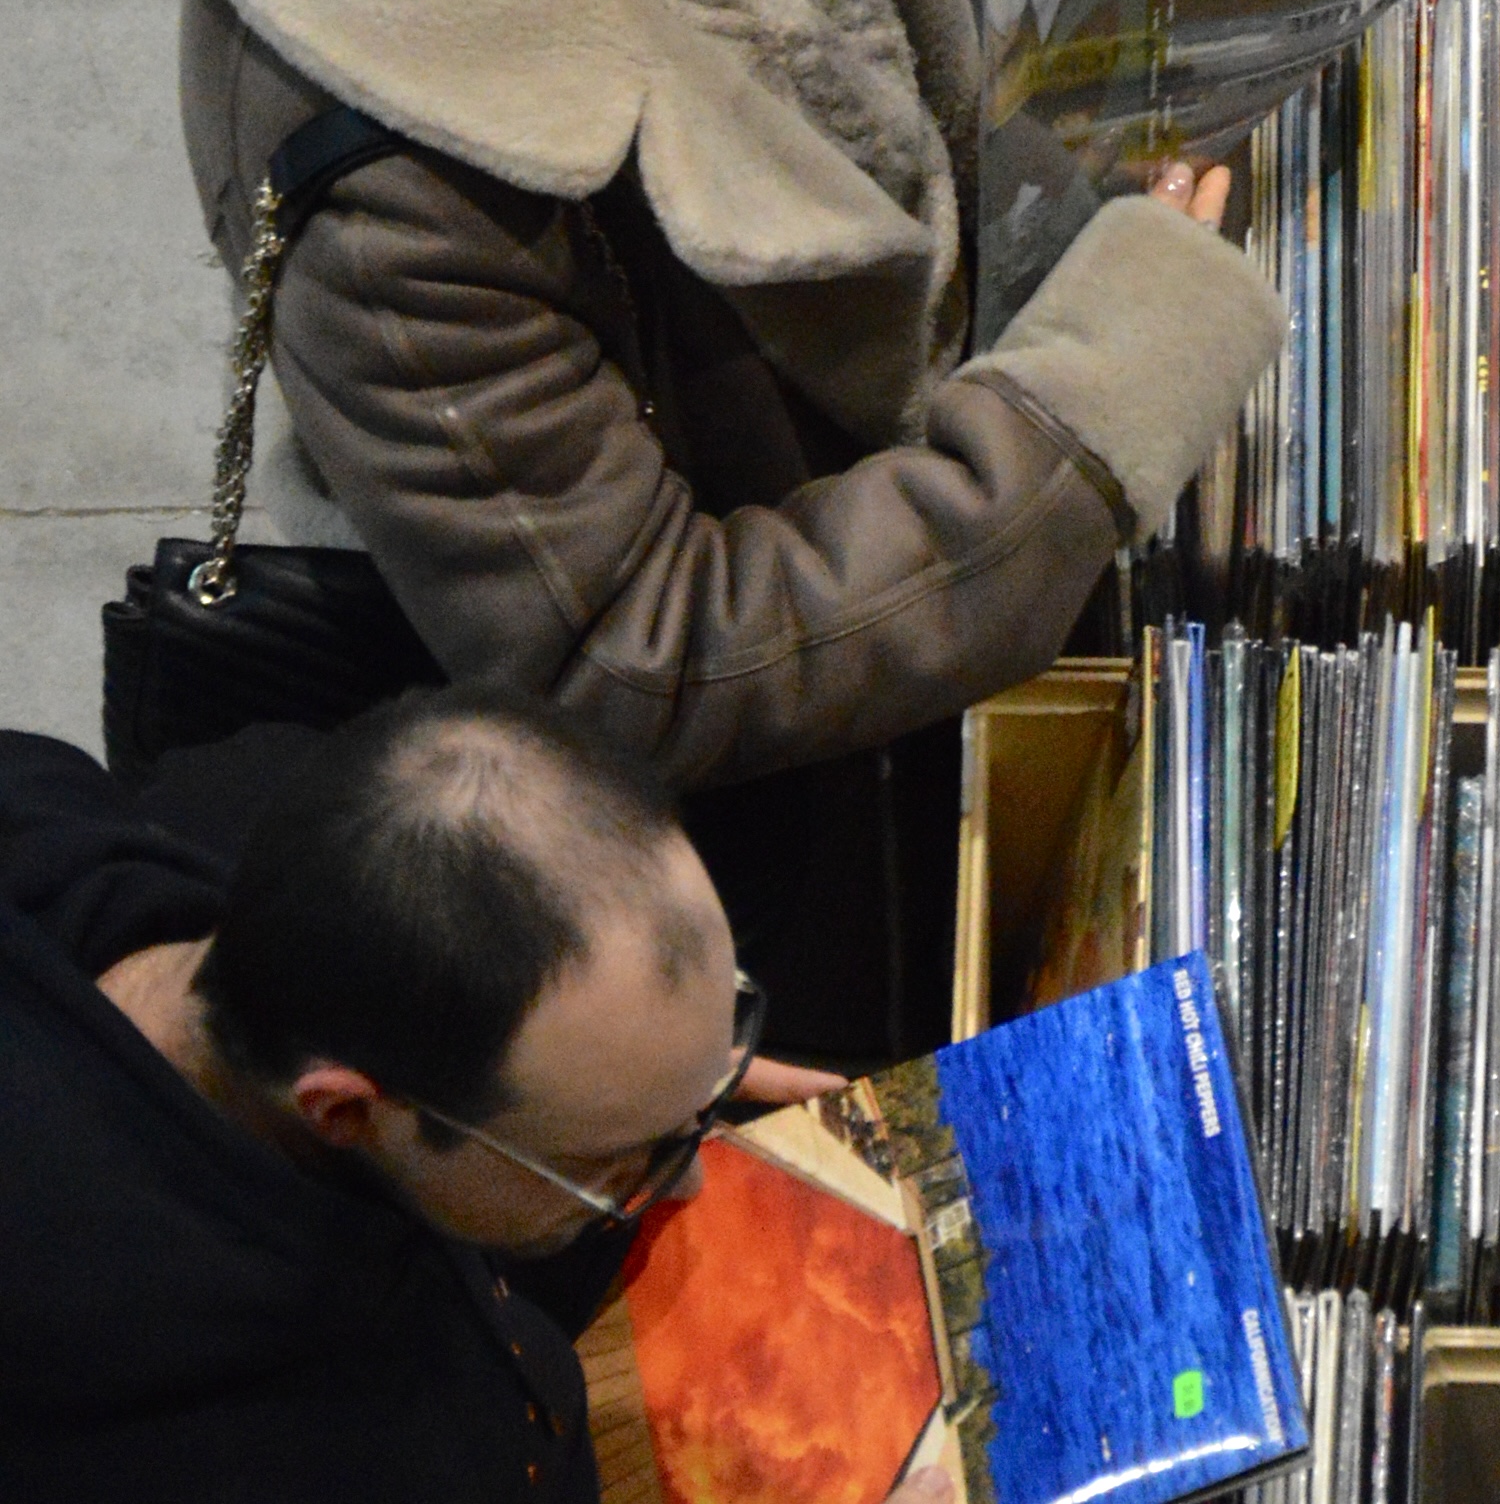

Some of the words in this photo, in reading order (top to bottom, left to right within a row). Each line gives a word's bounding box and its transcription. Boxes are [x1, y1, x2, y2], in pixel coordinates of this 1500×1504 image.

[1173, 968, 1193, 1000] RED
[1179, 1000, 1200, 1030] HOT
[1185, 1031, 1208, 1072] CHILI
[1193, 1071, 1222, 1138] PEPPERS
